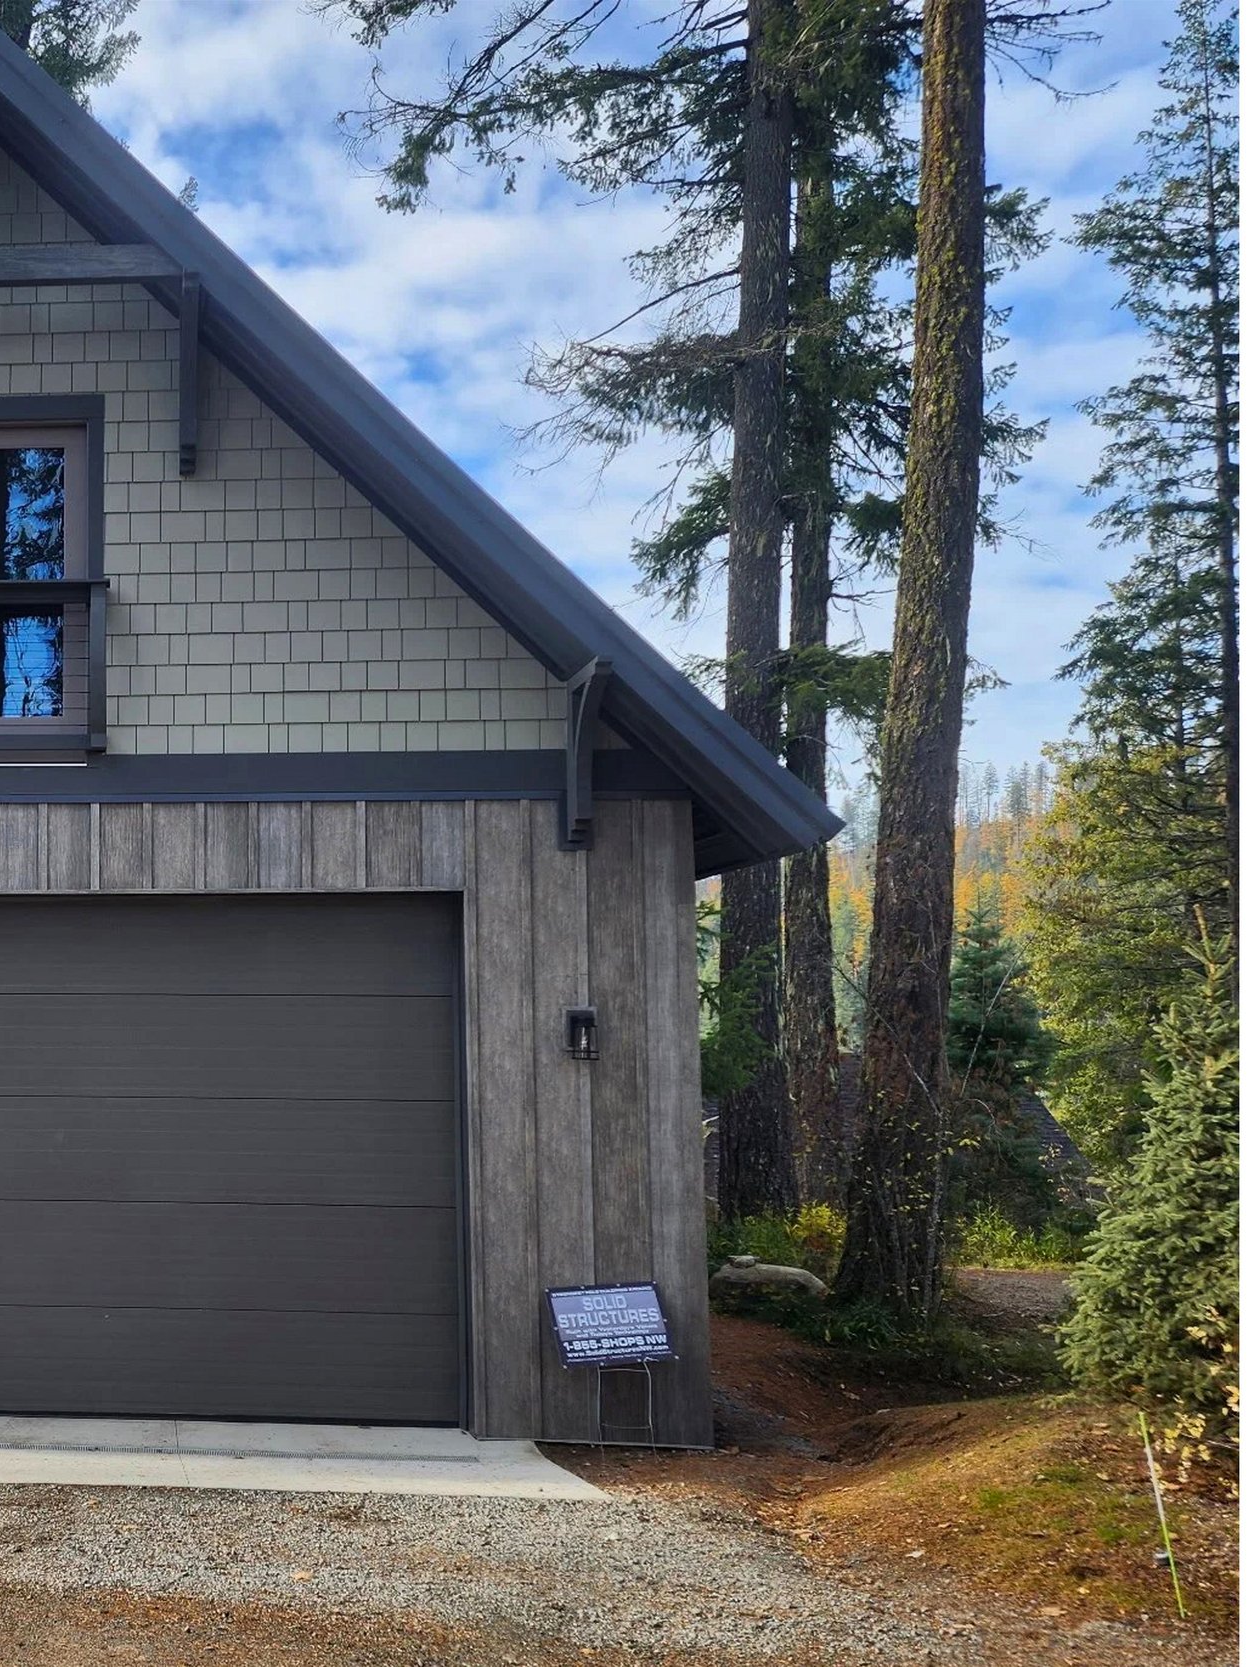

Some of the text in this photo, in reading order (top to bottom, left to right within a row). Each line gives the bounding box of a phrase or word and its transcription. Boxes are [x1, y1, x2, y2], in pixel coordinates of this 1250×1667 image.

[583, 1295, 627, 1311] SOLID
[558, 1308, 660, 1328] STRUCTURES
[563, 1334, 667, 1351] 1-855-SHOPS NW
